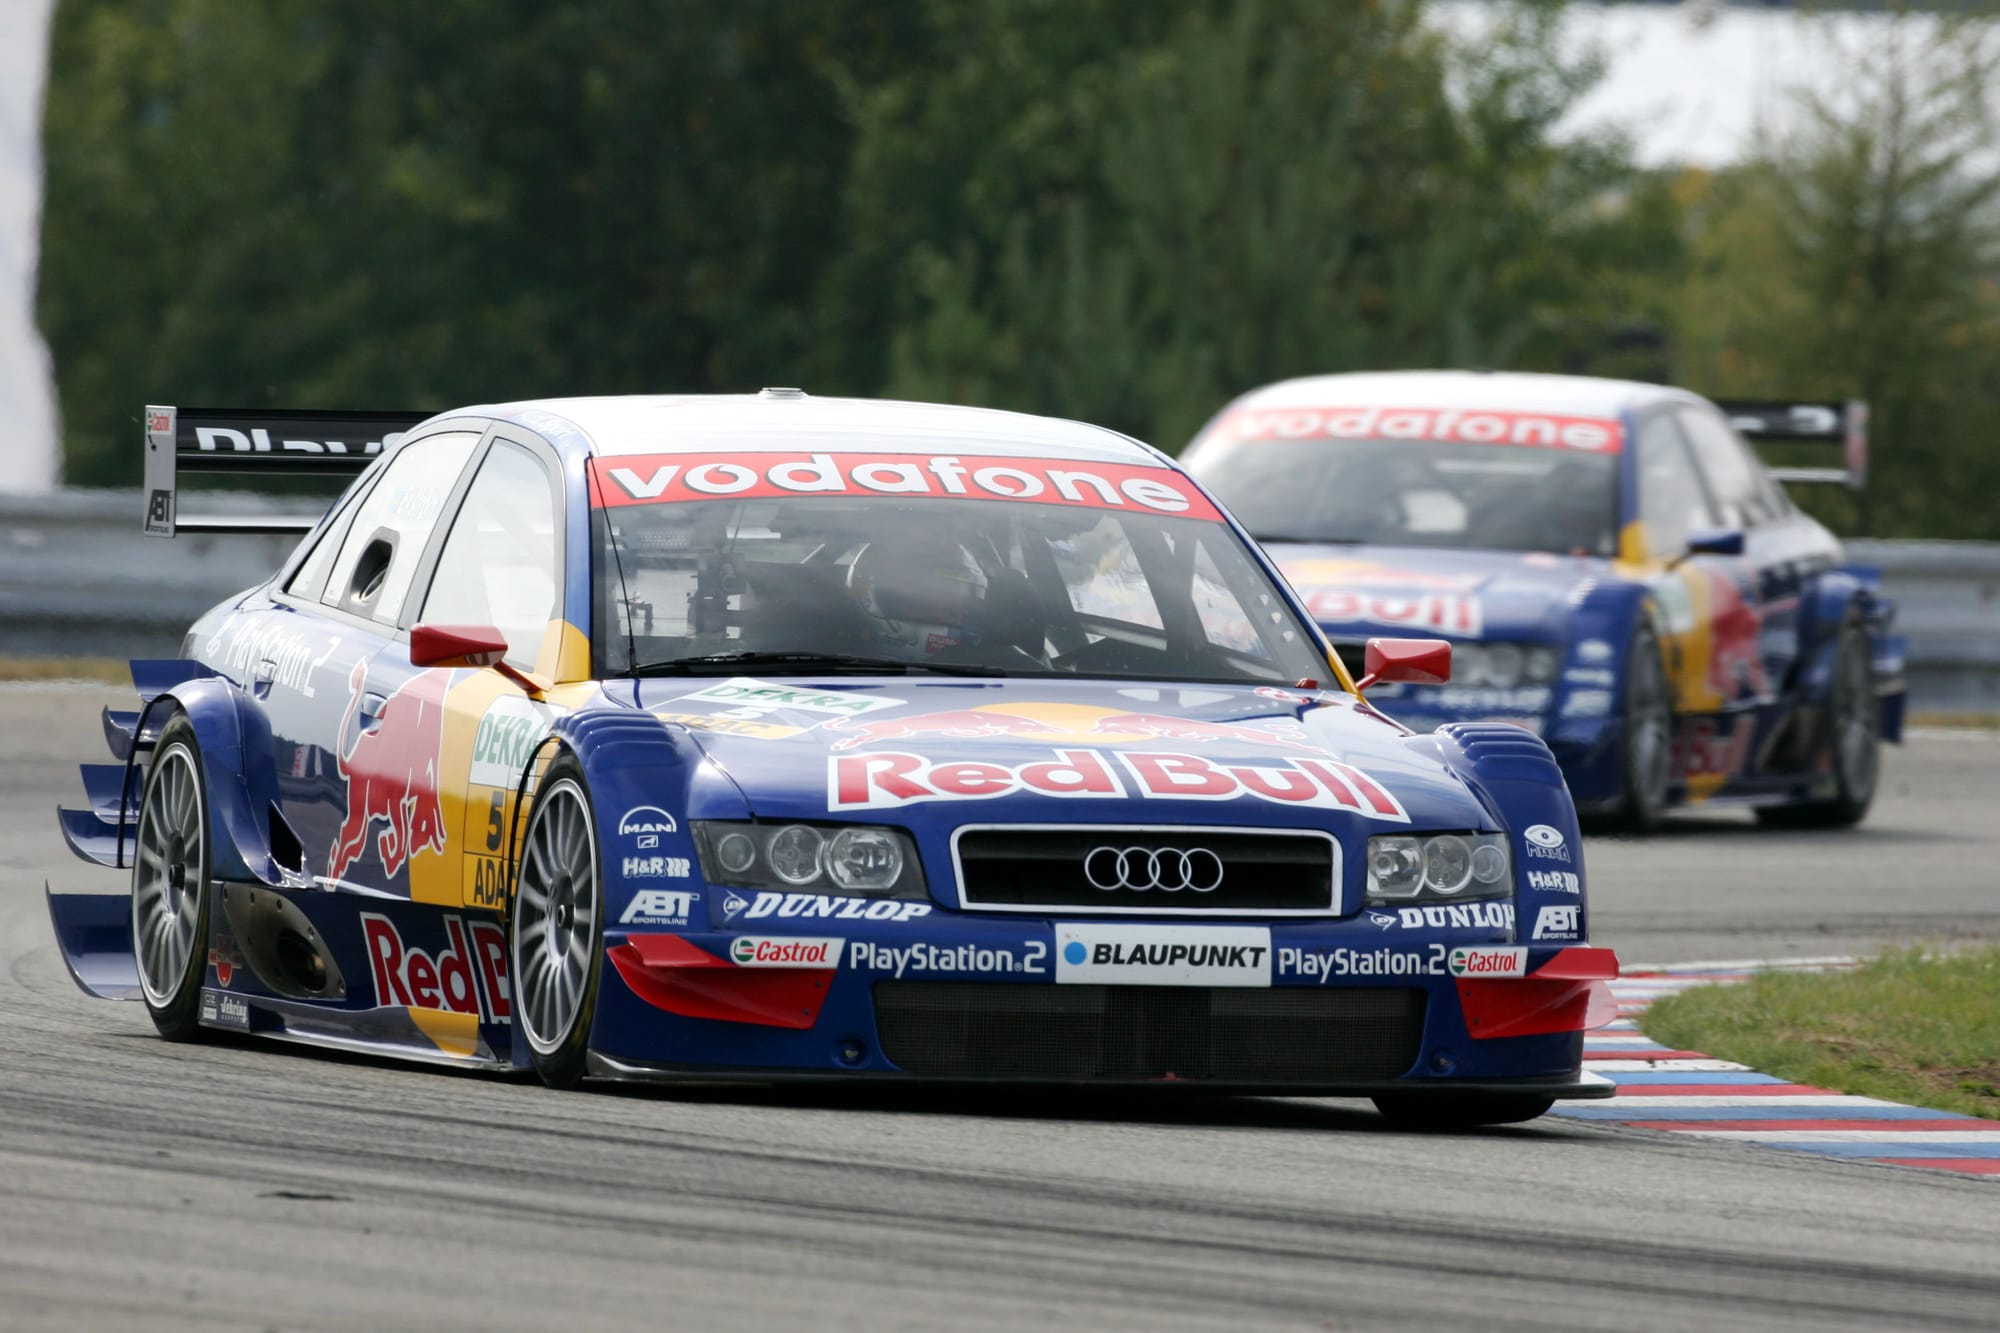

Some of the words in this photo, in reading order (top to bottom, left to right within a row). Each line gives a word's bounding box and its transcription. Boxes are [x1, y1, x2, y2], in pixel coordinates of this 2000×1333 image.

[1238, 408, 1609, 450] vodafone
[608, 454, 1191, 512] vodafone
[701, 685, 876, 711] DEKRA
[832, 750, 1121, 809] Red
[1116, 752, 1406, 820] Bull
[486, 791, 504, 852] 5
[624, 823, 672, 834] MAN
[623, 857, 665, 877] H&R
[1527, 870, 1564, 891] H&R
[619, 889, 692, 924] ABT
[744, 892, 932, 922] DUNLOP
[1532, 905, 1578, 940] ABT
[360, 911, 484, 1022] Red
[756, 941, 828, 963] Castrol
[1092, 943, 1266, 968] BLAUPUNKT
[1467, 951, 1517, 972] Castrol
